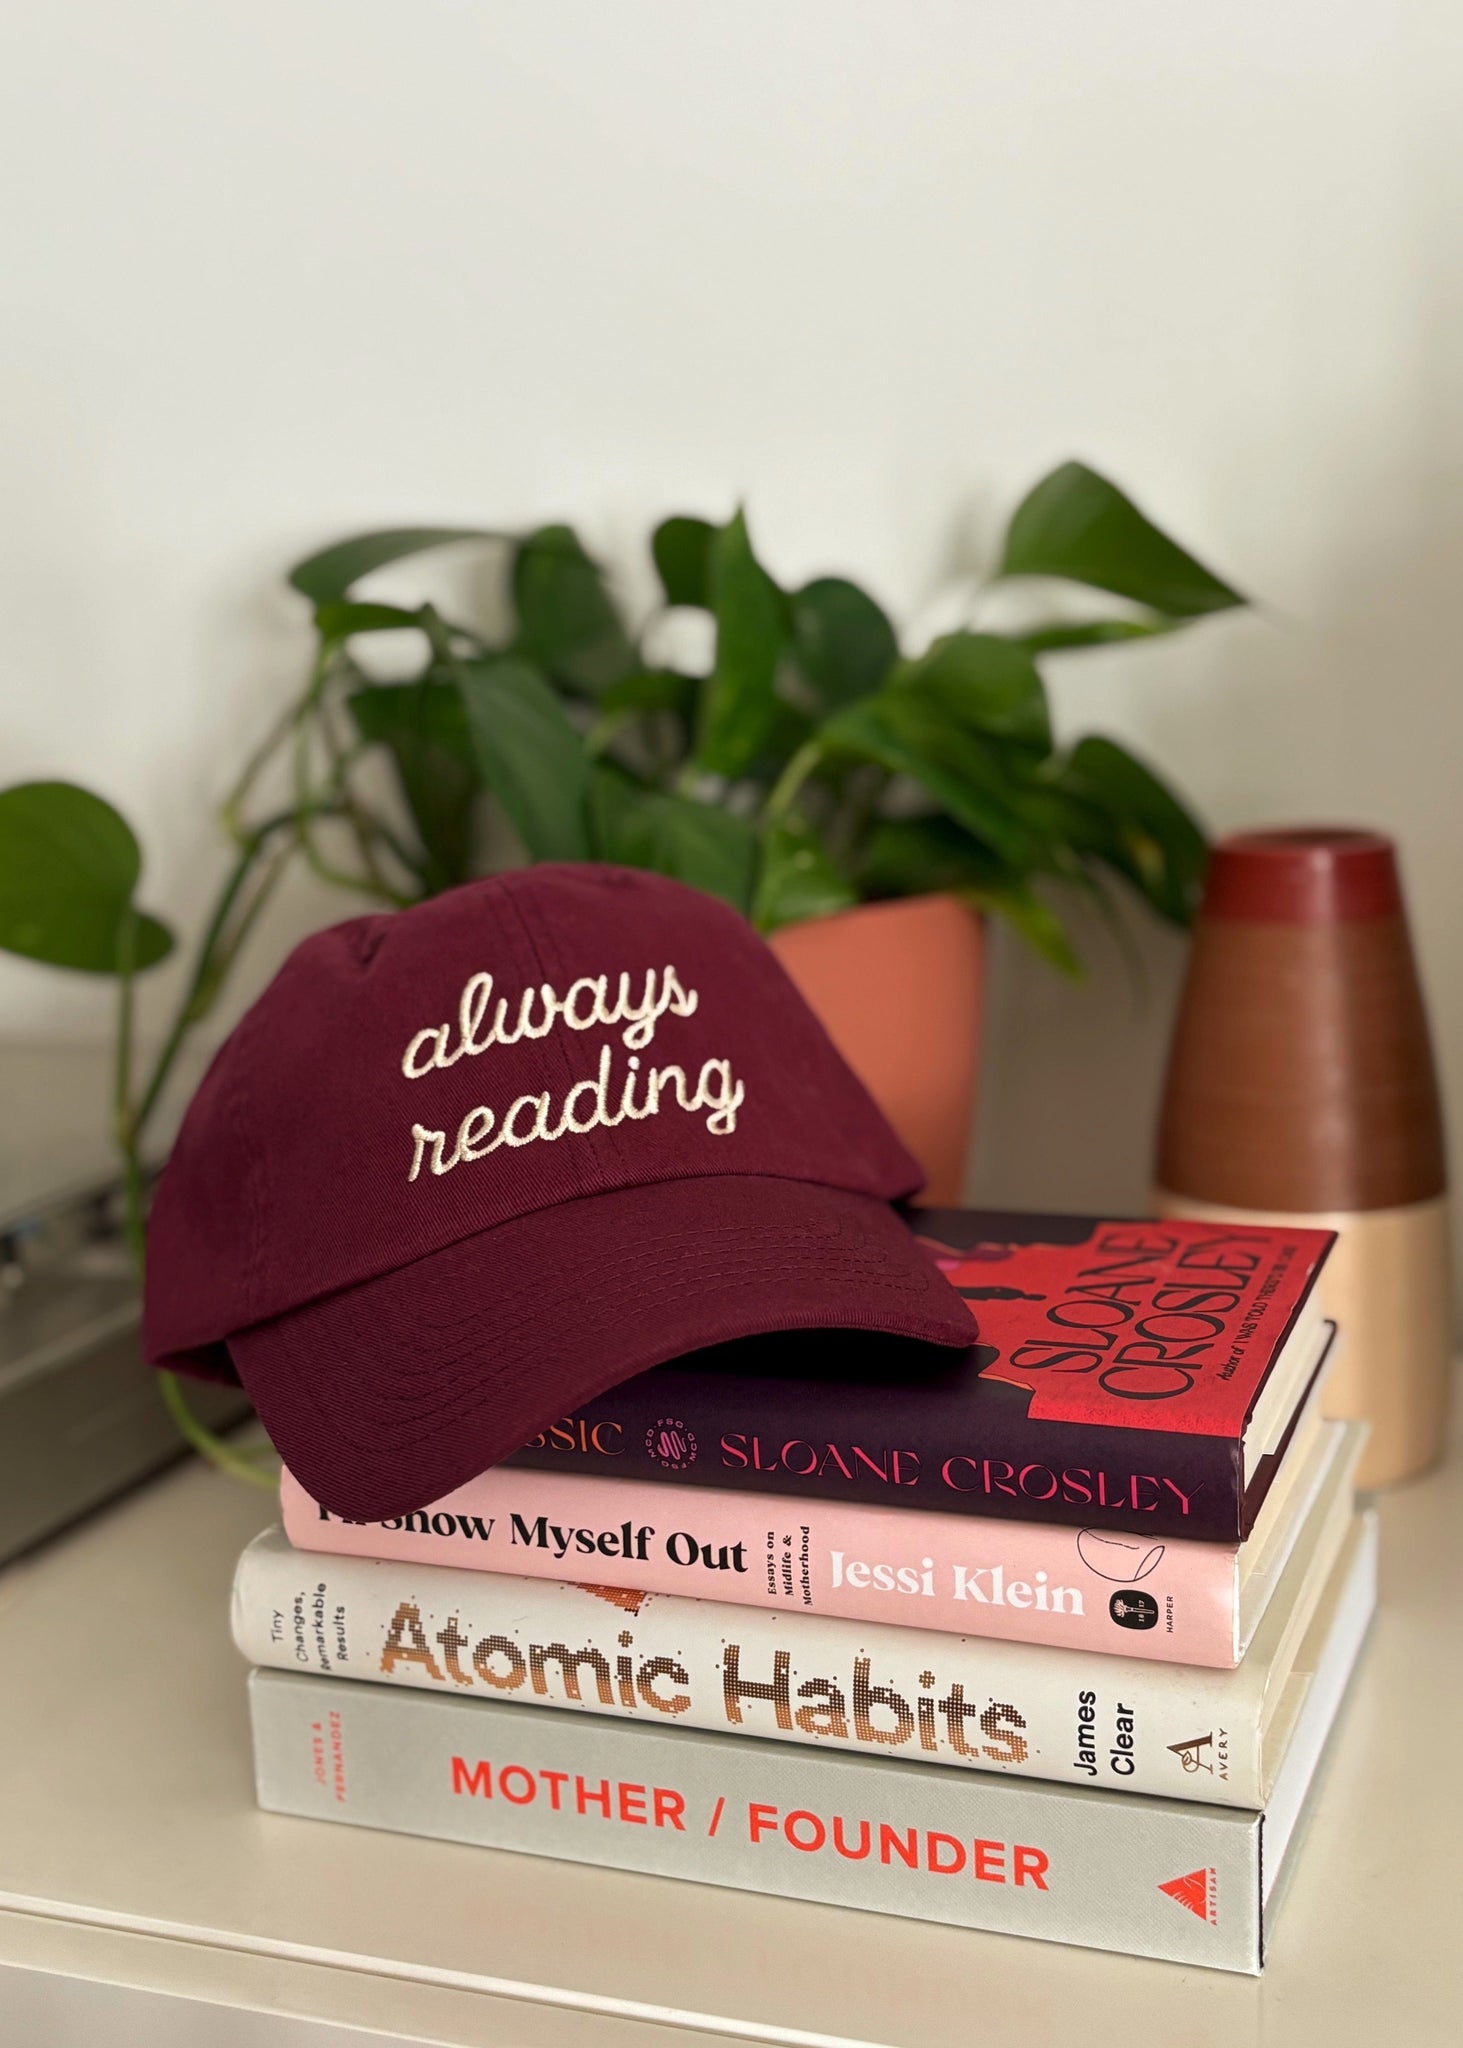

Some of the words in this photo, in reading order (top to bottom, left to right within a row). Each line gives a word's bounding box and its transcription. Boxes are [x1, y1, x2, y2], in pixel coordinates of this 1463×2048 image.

[402, 965, 698, 1079] always
[407, 1044, 744, 1183] reading
[1009, 1231, 1179, 1373] SLOANE
[1098, 1232, 1272, 1400] CROSLEY
[1234, 1322, 1258, 1340] WAS
[1244, 1302, 1268, 1321] TOLD
[1216, 1354, 1241, 1381] Author
[1231, 1345, 1244, 1355] of
[720, 1433, 921, 1486] SLOANE
[941, 1455, 1206, 1515] CROSLEY
[510, 1513, 655, 1560] Myself
[666, 1531, 748, 1573] Out
[767, 1531, 775, 1549] on
[782, 1535, 792, 1546] &
[799, 1526, 813, 1606] Motherhood
[767, 1554, 777, 1595] Essays
[782, 1552, 794, 1596] Midlife
[830, 1550, 935, 1598] Jessi
[952, 1563, 1086, 1616] Klein
[271, 1609, 284, 1643] Tiny
[294, 1591, 309, 1662] Changes,
[312, 1583, 332, 1671] Remarkable
[332, 1606, 349, 1661] Results
[1166, 1596, 1174, 1633] HARPER
[380, 1602, 691, 1714] Atomic
[723, 1644, 1029, 1763] Habits
[313, 1738, 327, 1786] JONES
[329, 1710, 346, 1803] FERNANDEZ
[1073, 1690, 1097, 1776] James
[1110, 1703, 1135, 1776] Clear
[1219, 1728, 1228, 1781] AVERY
[451, 1756, 686, 1831] MOTHER
[708, 1797, 725, 1837] /
[748, 1802, 1049, 1891] FOUNDER
[1209, 1867, 1217, 1926] ARTISAN
